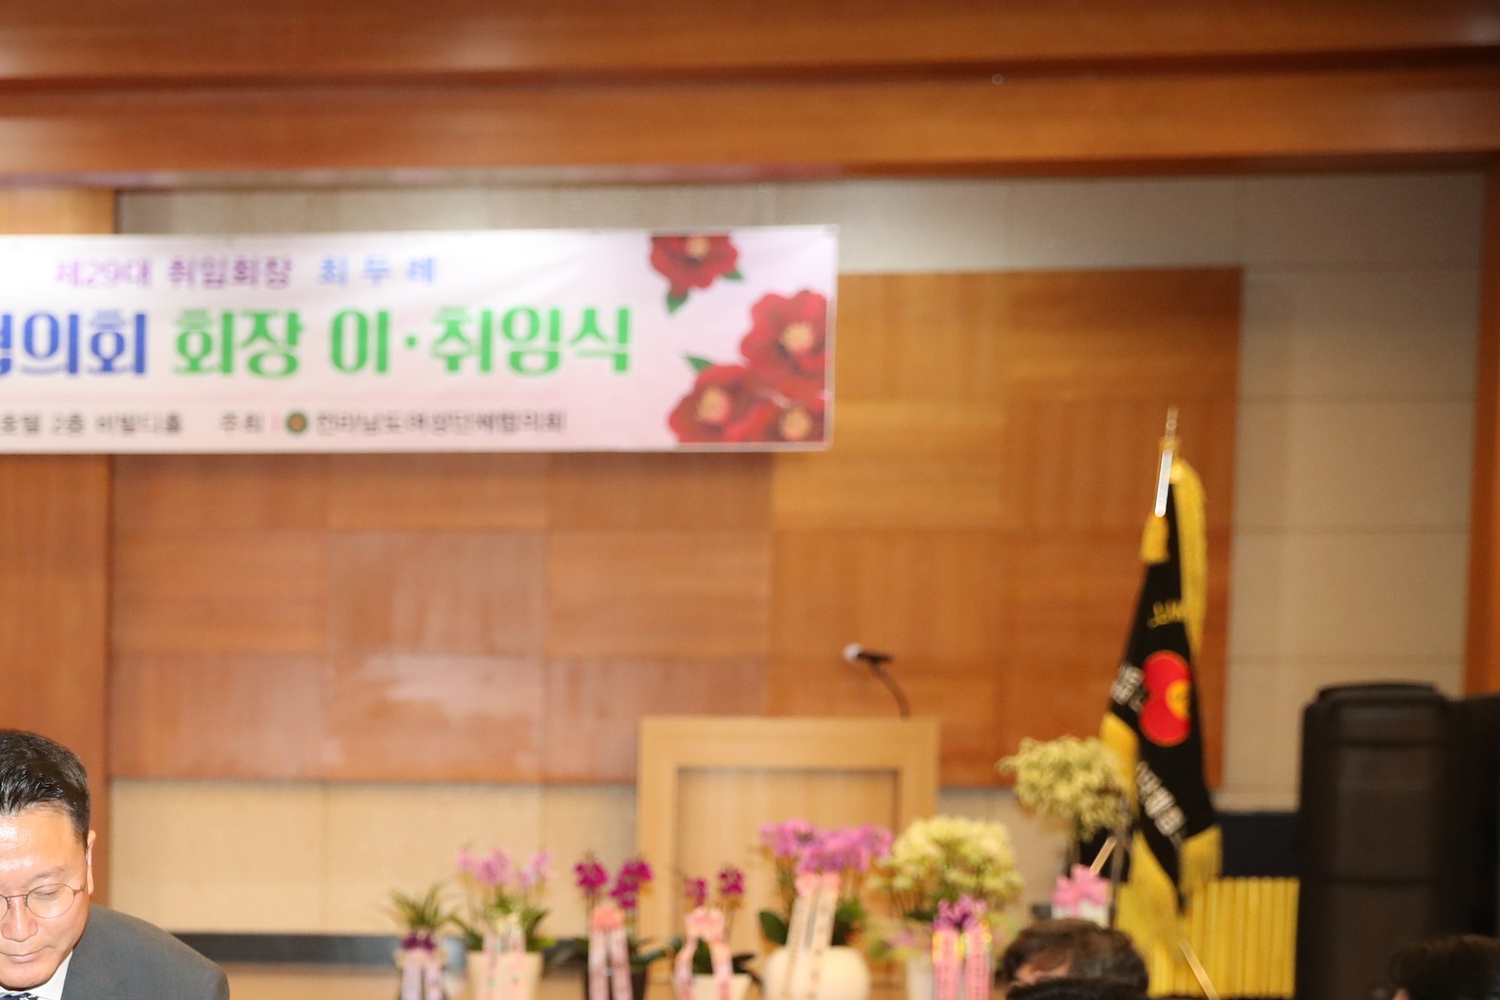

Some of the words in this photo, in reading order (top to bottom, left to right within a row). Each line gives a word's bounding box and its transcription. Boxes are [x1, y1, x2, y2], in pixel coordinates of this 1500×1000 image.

[54, 258, 151, 288] 제29대
[166, 257, 294, 288] 취임회장
[170, 306, 306, 379] 회장
[327, 303, 633, 376] 이·취임식
